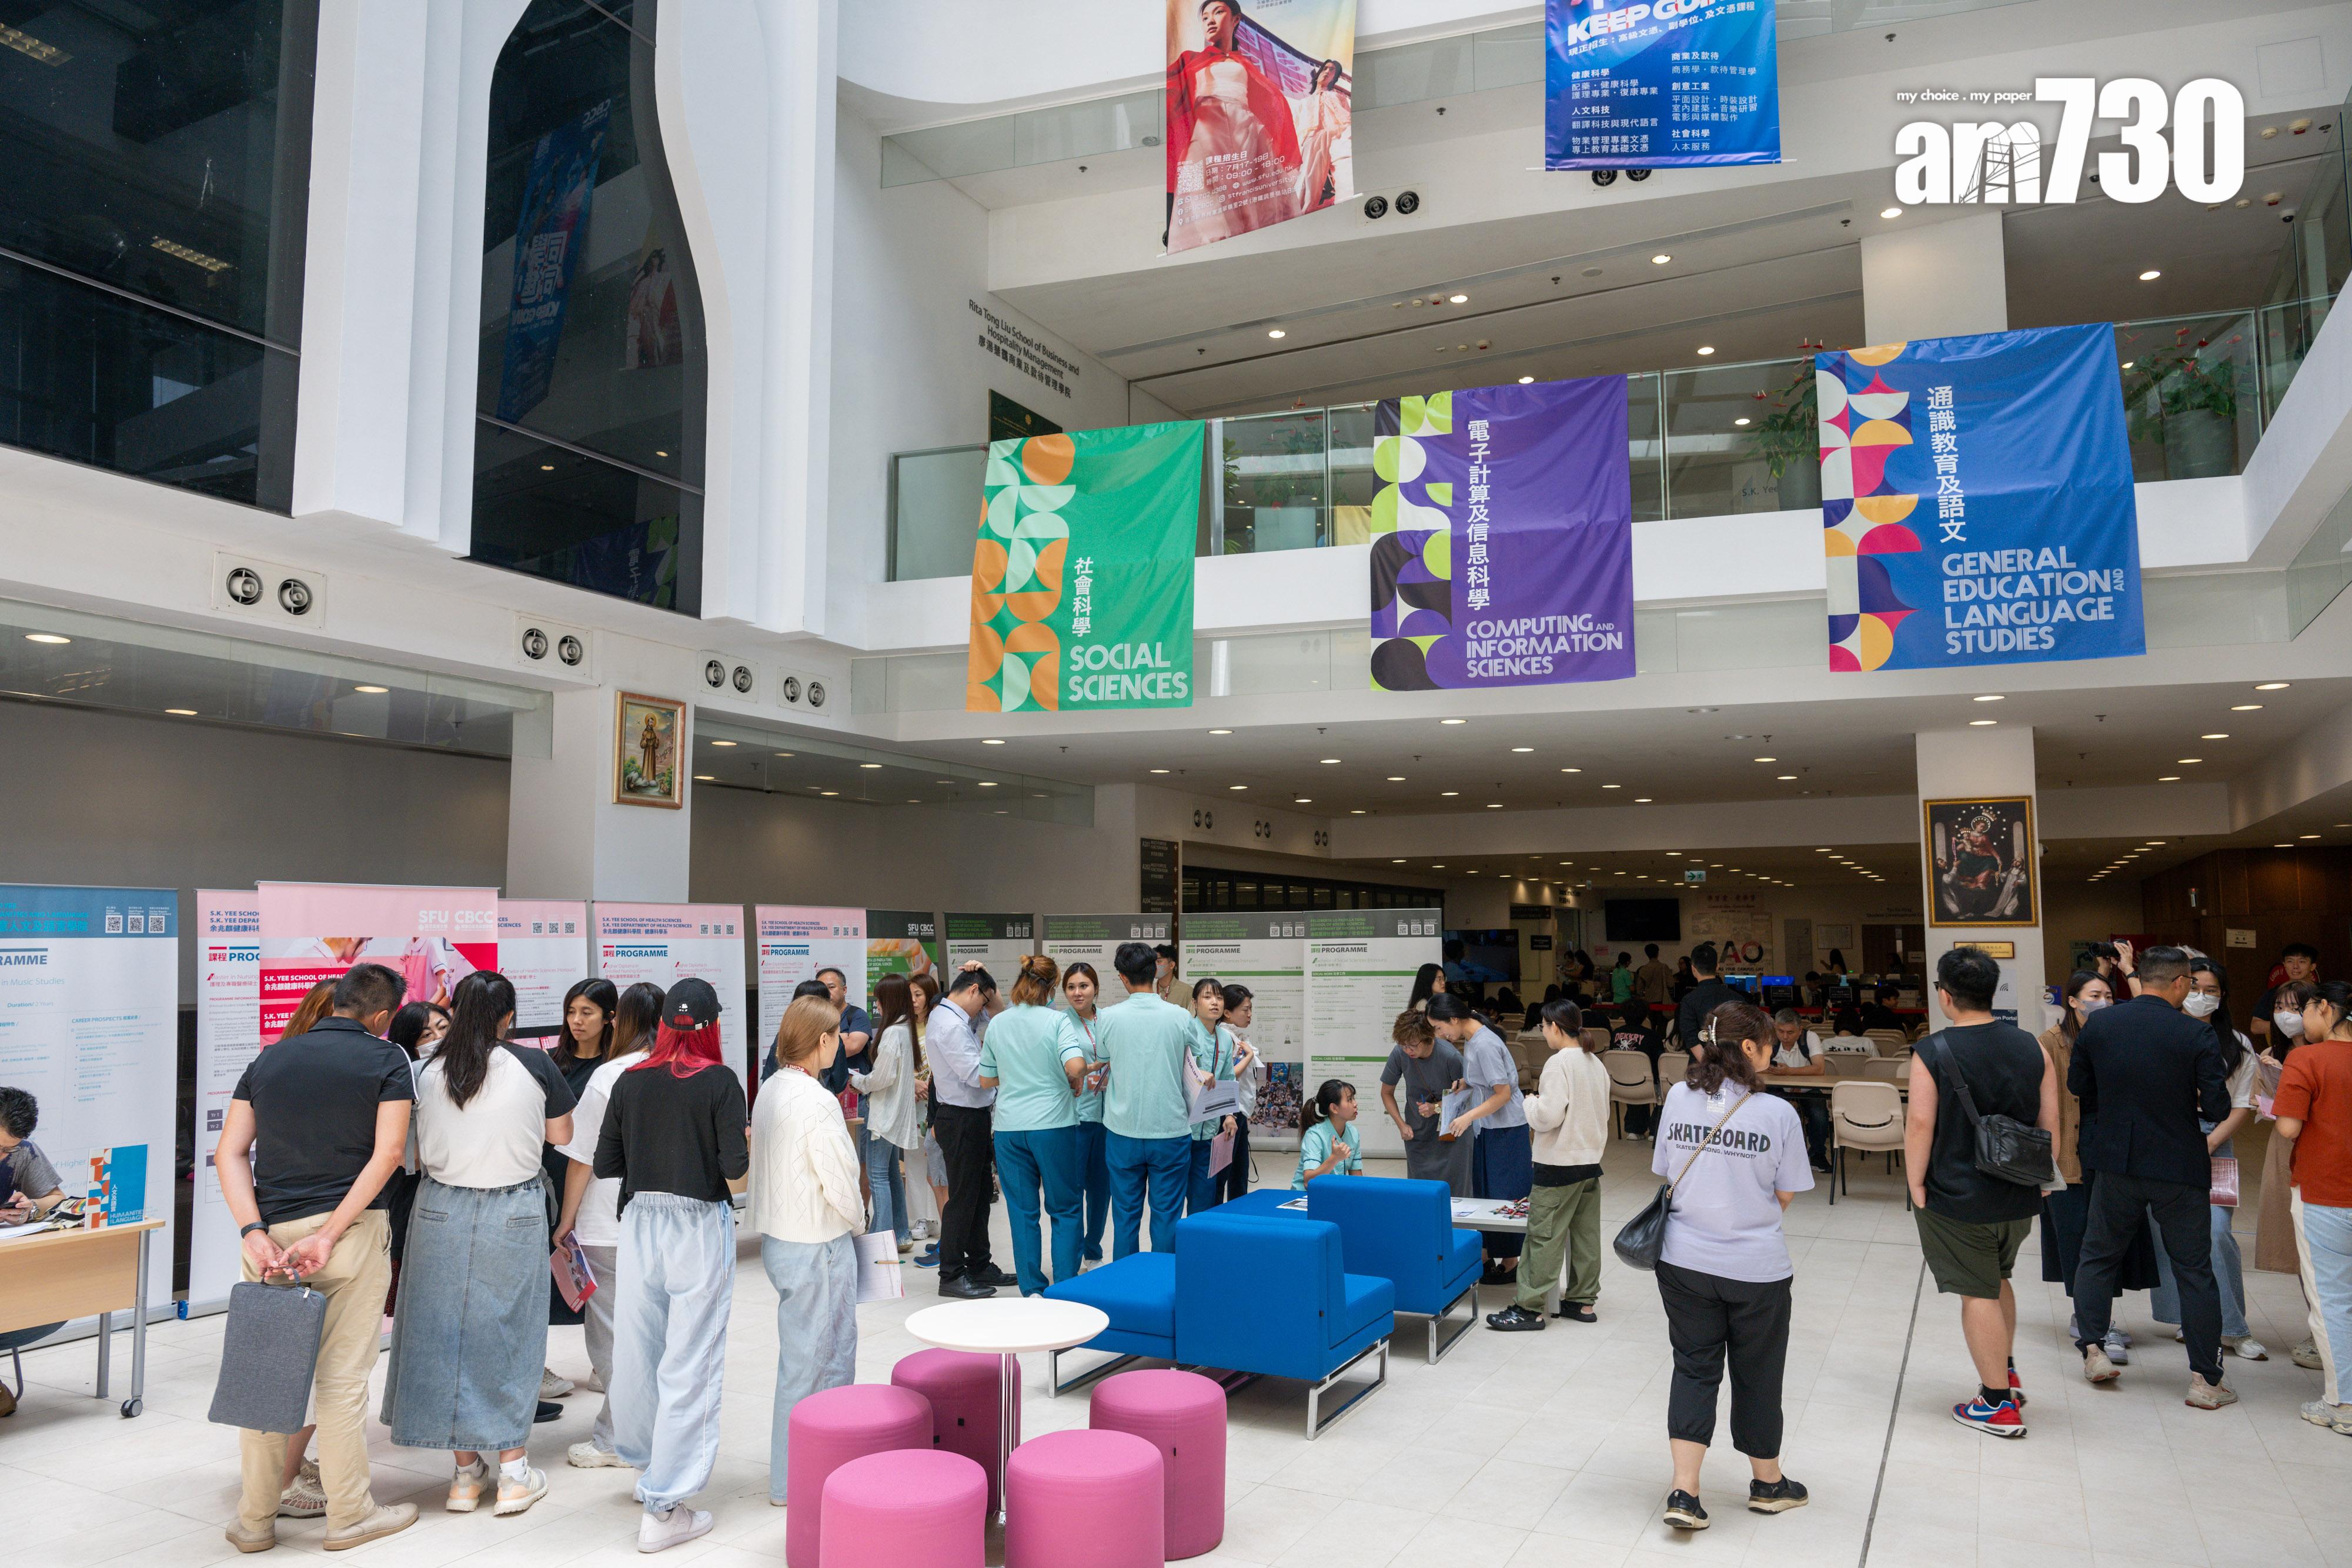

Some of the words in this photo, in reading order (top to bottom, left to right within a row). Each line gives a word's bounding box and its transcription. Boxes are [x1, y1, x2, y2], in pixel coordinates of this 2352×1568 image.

[1568, 4, 1650, 46] KEEP
[1672, 52, 1719, 61] 商業及款待
[1571, 68, 1610, 79] 健康科學
[1672, 82, 1710, 91] 創意工業
[1572, 106, 1610, 116] 人文科技
[1572, 135, 1649, 145] 物業管理專業文憑
[1672, 129, 1710, 138] 社會科學
[1572, 143, 1649, 155] 專上教育基礎文憑
[1672, 142, 1710, 151] 人本服務
[1206, 151, 1247, 165] 課程招生日
[1261, 156, 1285, 168] 18:00
[1242, 165, 1294, 186] www.sfu.edu.hk
[969, 299, 983, 316] Rita
[983, 307, 1000, 329] Tong
[1001, 320, 1011, 334] Liu
[1012, 327, 1033, 348] School
[1034, 343, 1041, 352] of
[1042, 345, 1068, 369] Business
[1068, 364, 1080, 376] and
[988, 325, 1023, 356] Hospitality
[1023, 350, 1064, 379] Management
[1926, 385, 1967, 543] 通識教育及語文
[1466, 419, 1491, 611] 電子計算及信息科學
[1942, 546, 2076, 577] GENERAL
[1943, 569, 2111, 603] EDUCATION
[2113, 567, 2125, 591] AND
[1071, 556, 1094, 637] 社會科學
[1945, 596, 2115, 629] LANGUAGE
[1466, 613, 1593, 639] COMPUTING
[1596, 622, 1614, 631] AND
[1466, 631, 1623, 659] INFORMATION
[1946, 625, 2056, 655] STUDIES
[1070, 641, 1171, 671] SOCIAL
[1466, 656, 1553, 678] SCIENCES
[1068, 671, 1188, 701] SCIENCES
[418, 910, 449, 924] SFU
[454, 910, 494, 924] CBCC
[209, 952, 227, 961] 課程
[1667, 1122, 1770, 1152] SKATEBOARD
[61, 1159, 86, 1170] Higher
[1724, 1150, 1757, 1159] WHYNOT?
